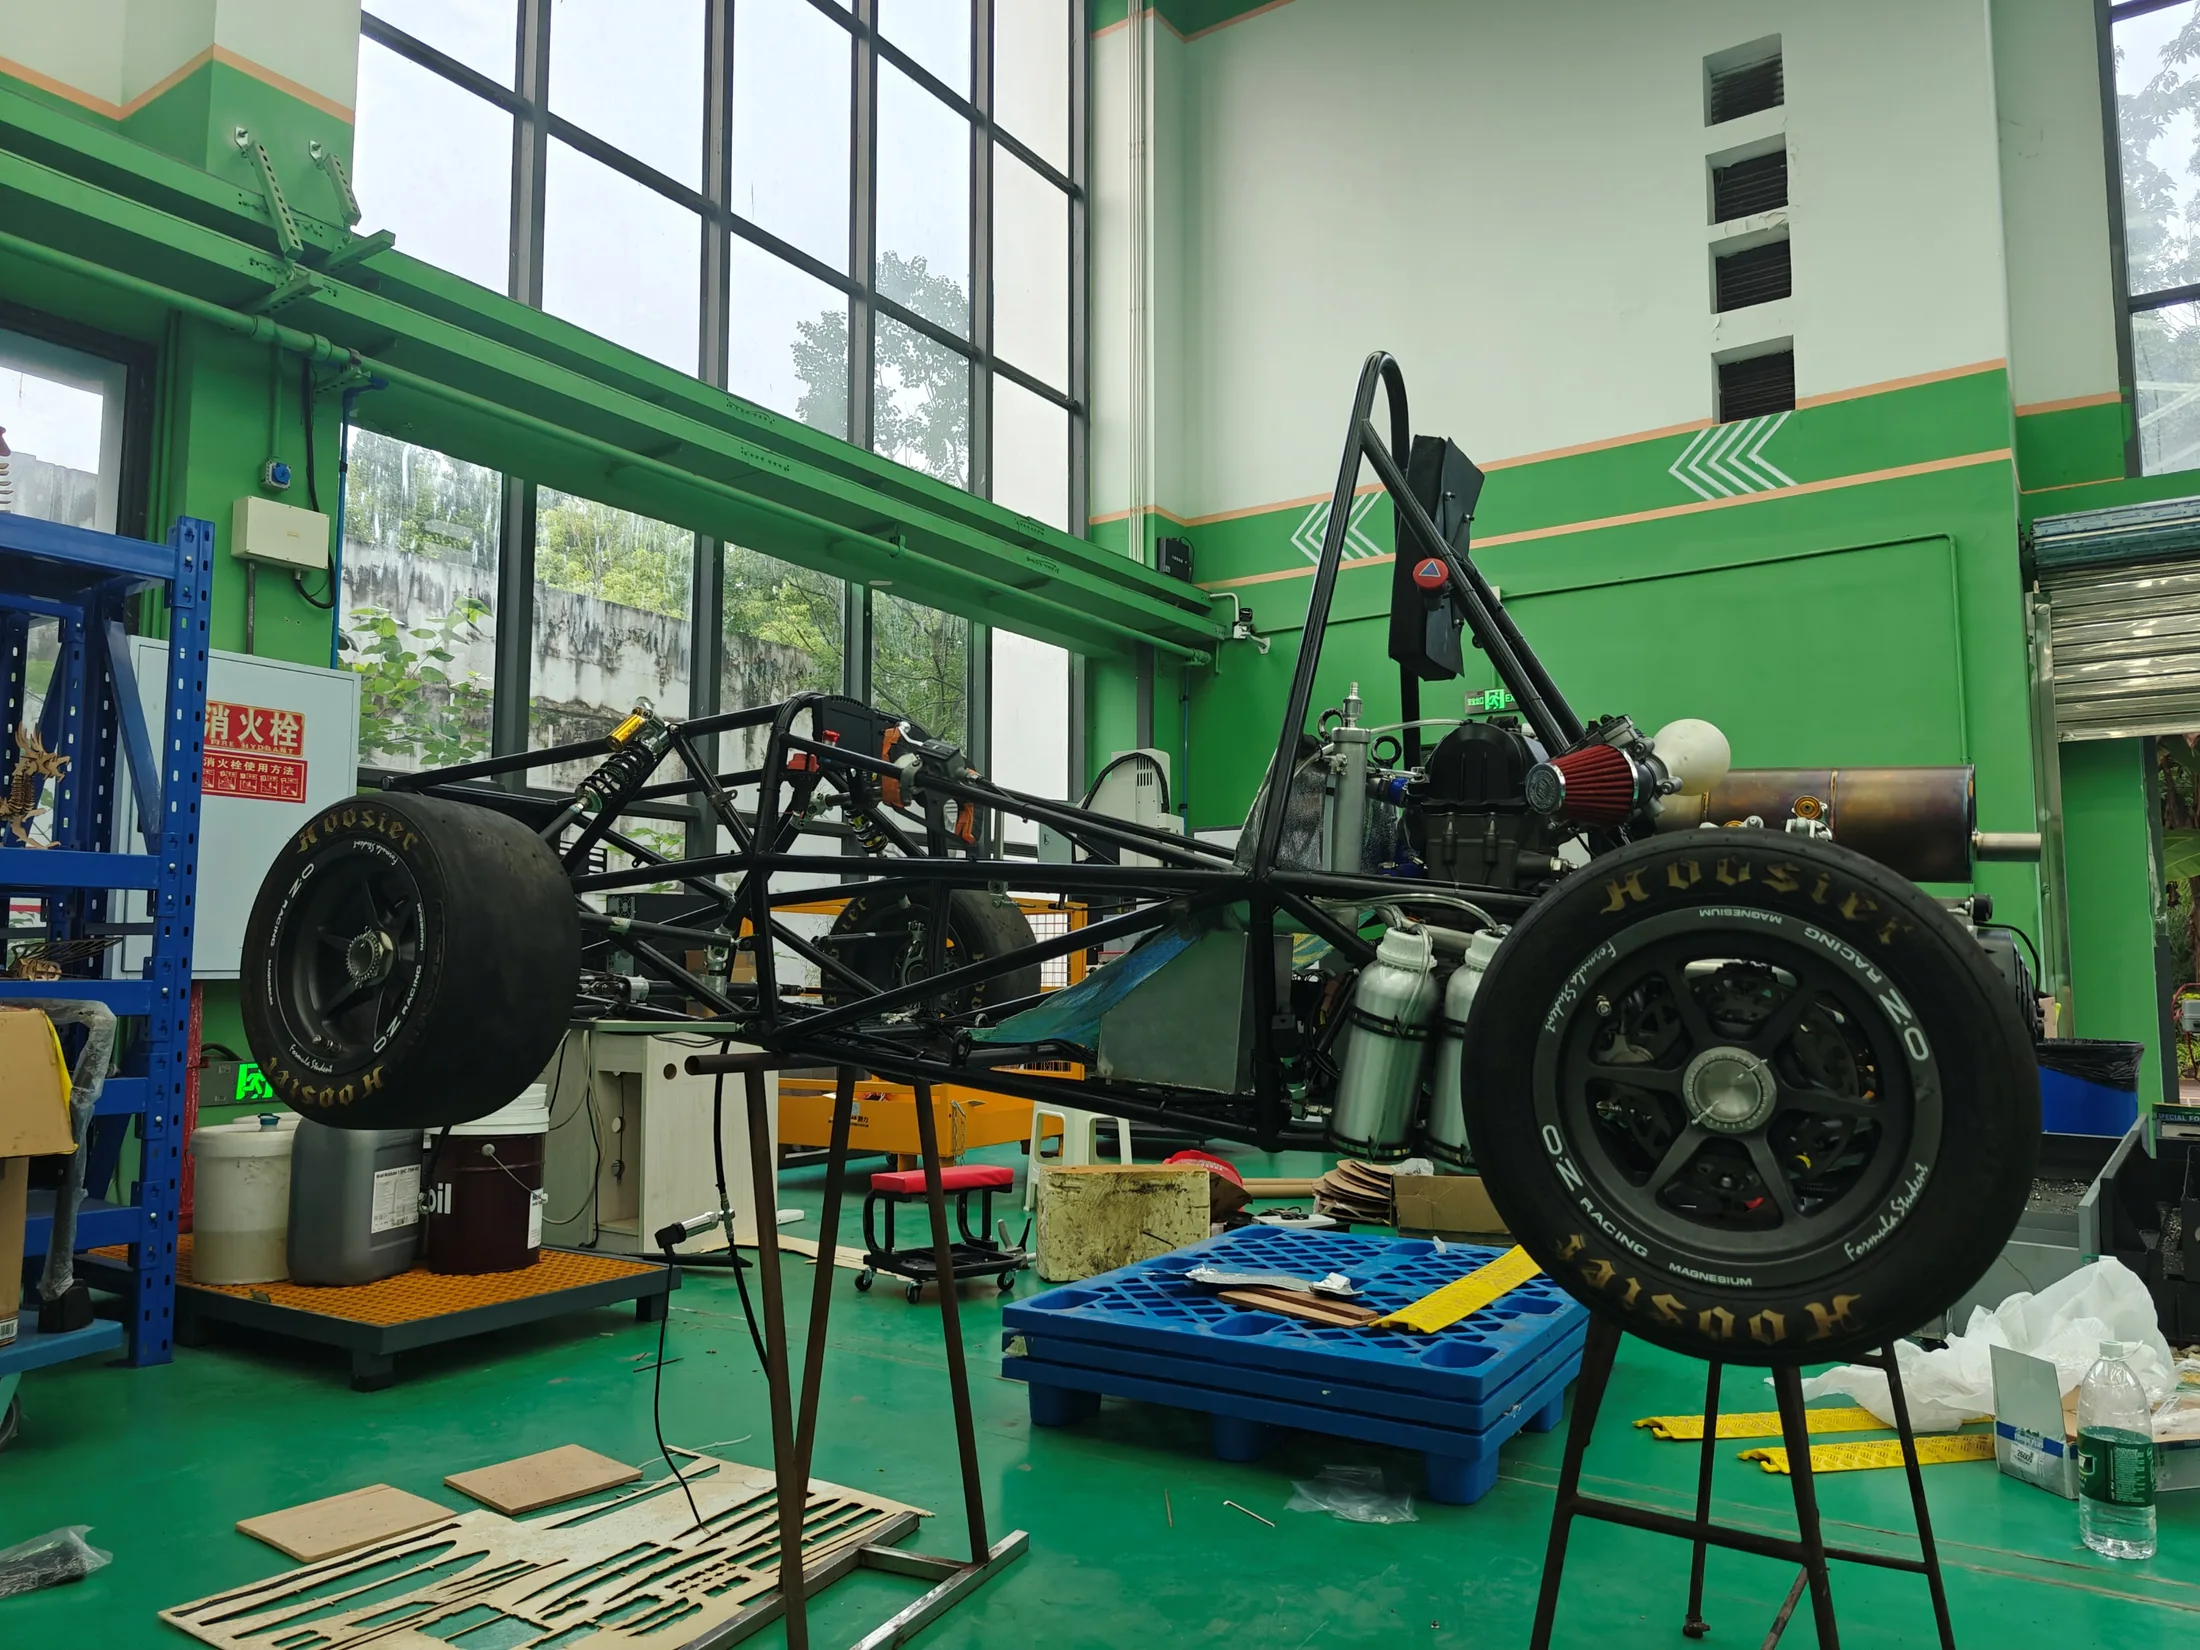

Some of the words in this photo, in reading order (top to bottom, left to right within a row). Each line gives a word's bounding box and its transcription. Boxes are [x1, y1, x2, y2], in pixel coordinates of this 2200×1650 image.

[205, 705, 300, 747] 消火栓
[210, 738, 235, 748] FIRE
[241, 743, 294, 754] HYDRANT
[203, 757, 295, 776] 消火栓使用方法
[297, 807, 418, 854] Hoosier
[269, 899, 289, 947] RACING
[1699, 908, 1783, 925] MAGNESIUM
[1570, 940, 1617, 985] Formula
[1803, 926, 1883, 984] RACING
[402, 964, 422, 1016] RACING
[1545, 984, 1577, 1033] Student
[288, 1043, 311, 1067] Formula
[309, 1058, 333, 1074] Student
[1579, 1197, 1649, 1258] RACING
[1844, 1215, 1899, 1261] Formula
[1890, 1162, 1929, 1217] Student
[1668, 1262, 1753, 1286] MAGNESIUM
